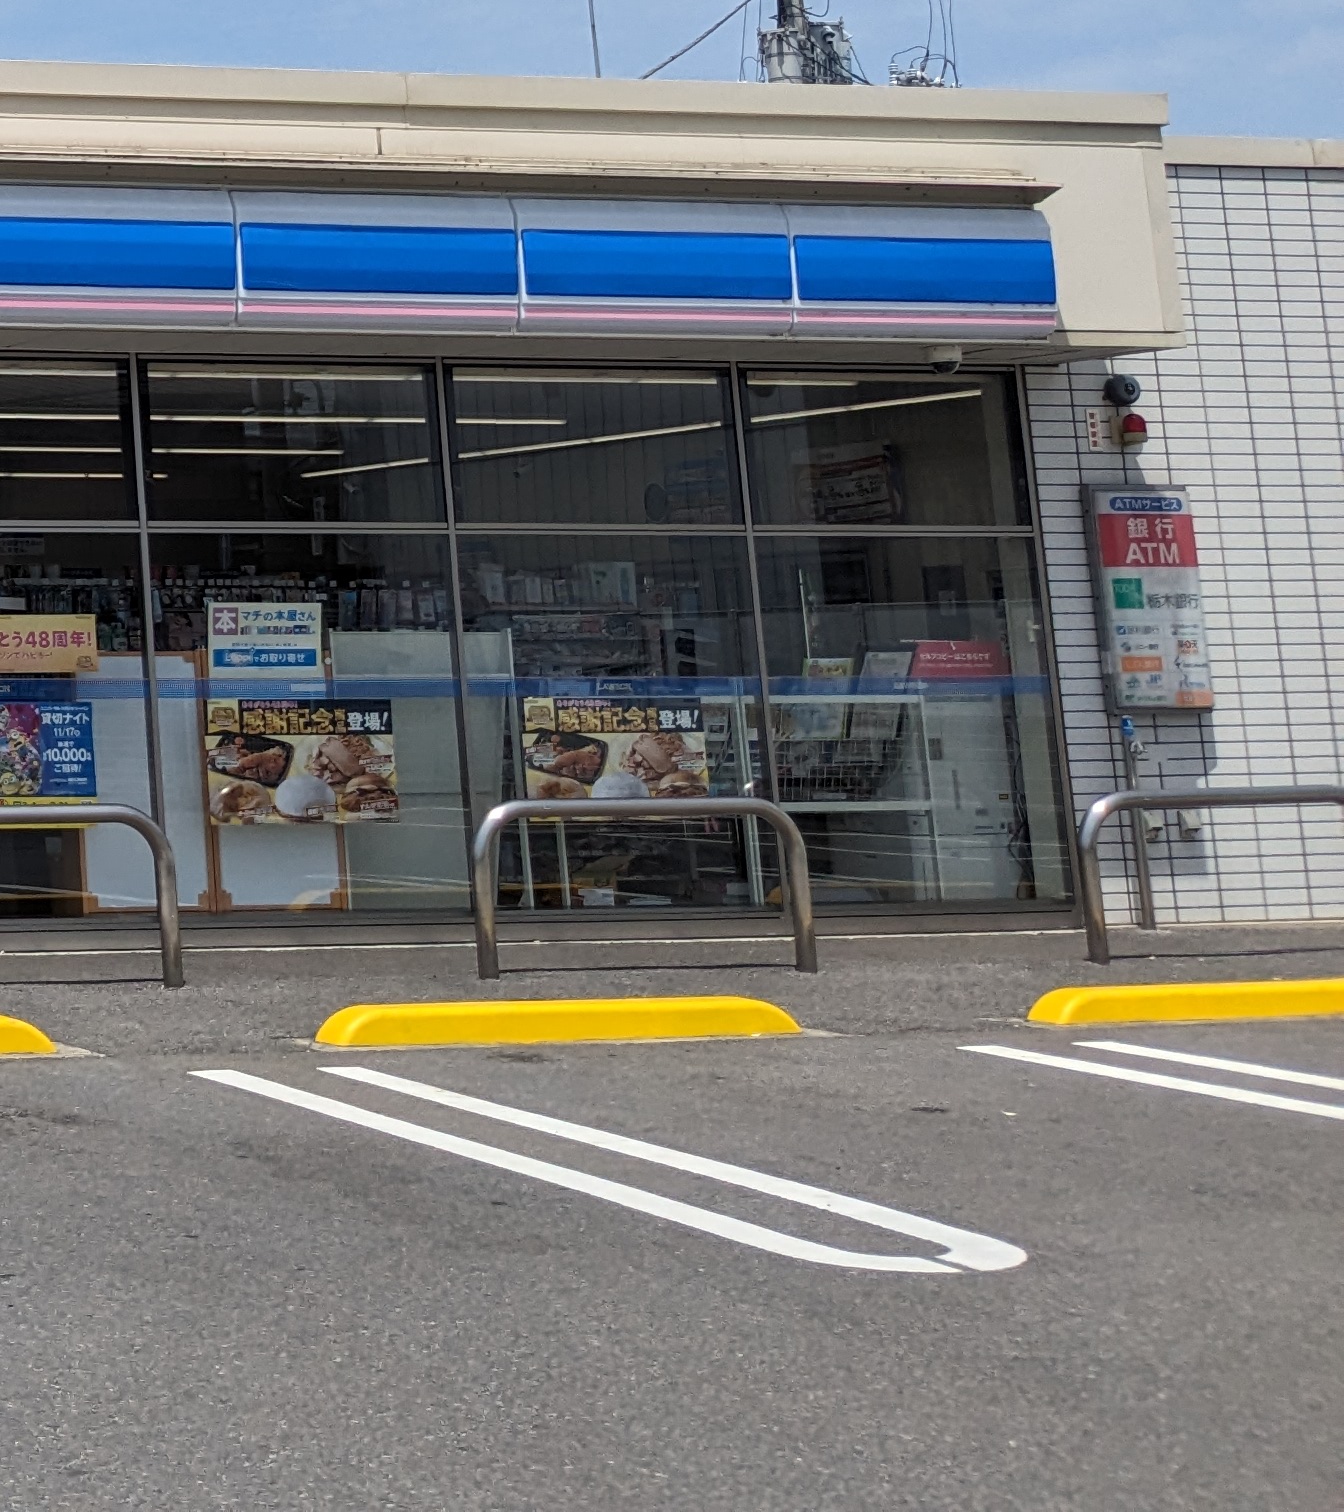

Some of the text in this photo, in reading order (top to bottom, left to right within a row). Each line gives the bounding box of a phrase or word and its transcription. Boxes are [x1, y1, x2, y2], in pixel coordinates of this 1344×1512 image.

[1114, 498, 1180, 510] ATMサービス
[1126, 517, 1175, 539] 銀行
[1125, 542, 1180, 564] ATM
[1146, 593, 1200, 609] 栃木銀行
[214, 609, 237, 633] 本
[240, 609, 317, 622] マチの本屋さん
